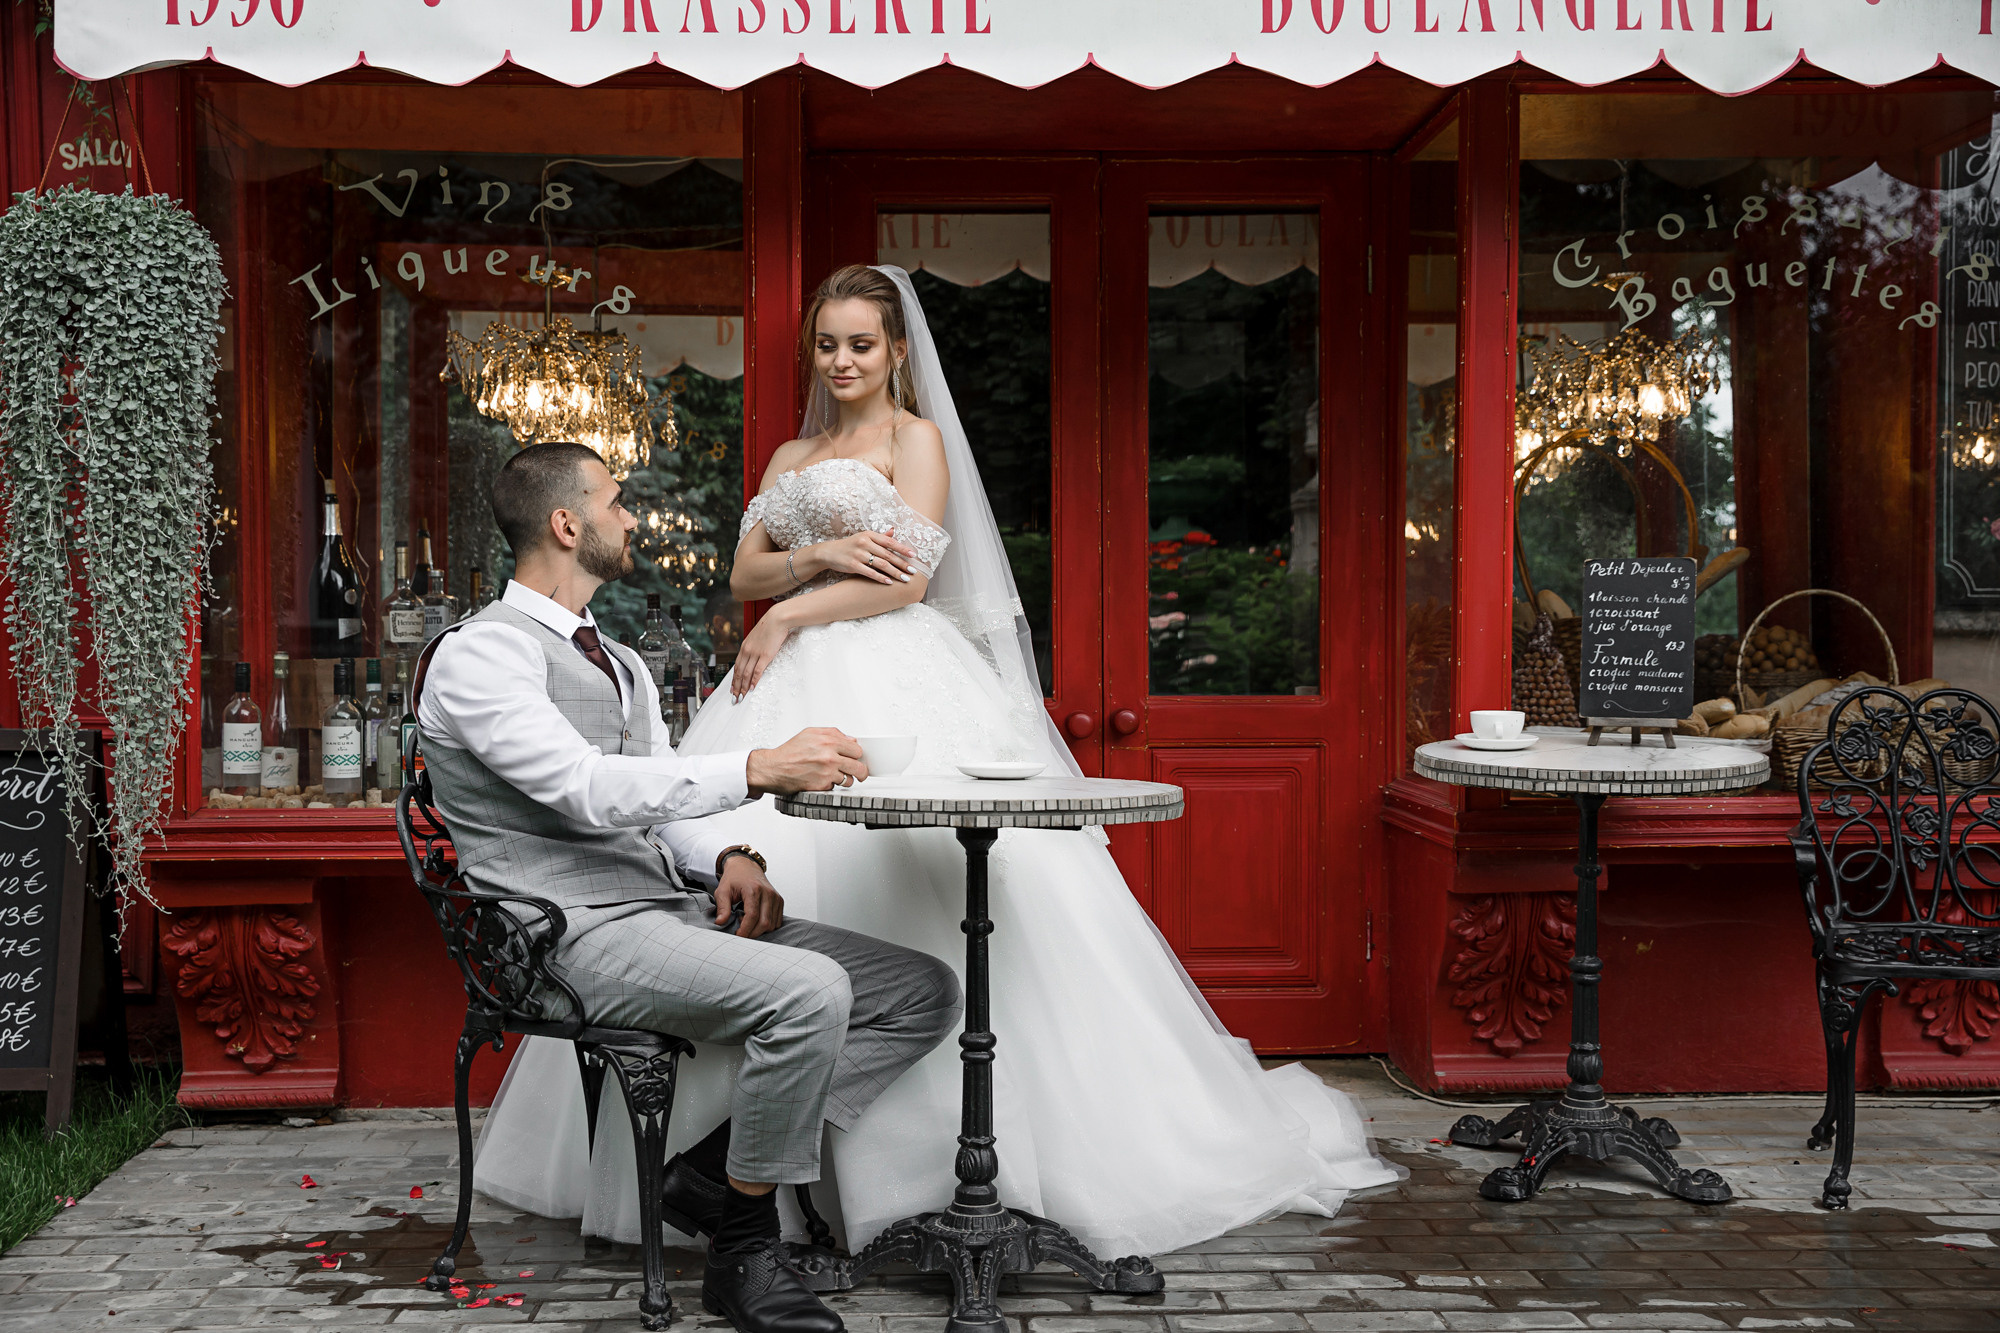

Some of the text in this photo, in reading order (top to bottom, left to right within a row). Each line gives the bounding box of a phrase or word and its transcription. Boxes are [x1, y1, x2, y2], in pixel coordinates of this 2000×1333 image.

[59, 138, 132, 171] SALO
[339, 165, 574, 223] Vins
[1552, 194, 1994, 289] Croissants
[288, 247, 637, 320] Liqueurs
[1609, 257, 1942, 333] Baguettes
[1967, 280, 2000, 308] RAN
[1965, 321, 2000, 349] AST
[1590, 561, 1625, 576] Petit
[1588, 638, 1660, 666] Formule
[1588, 681, 1628, 694] croque
